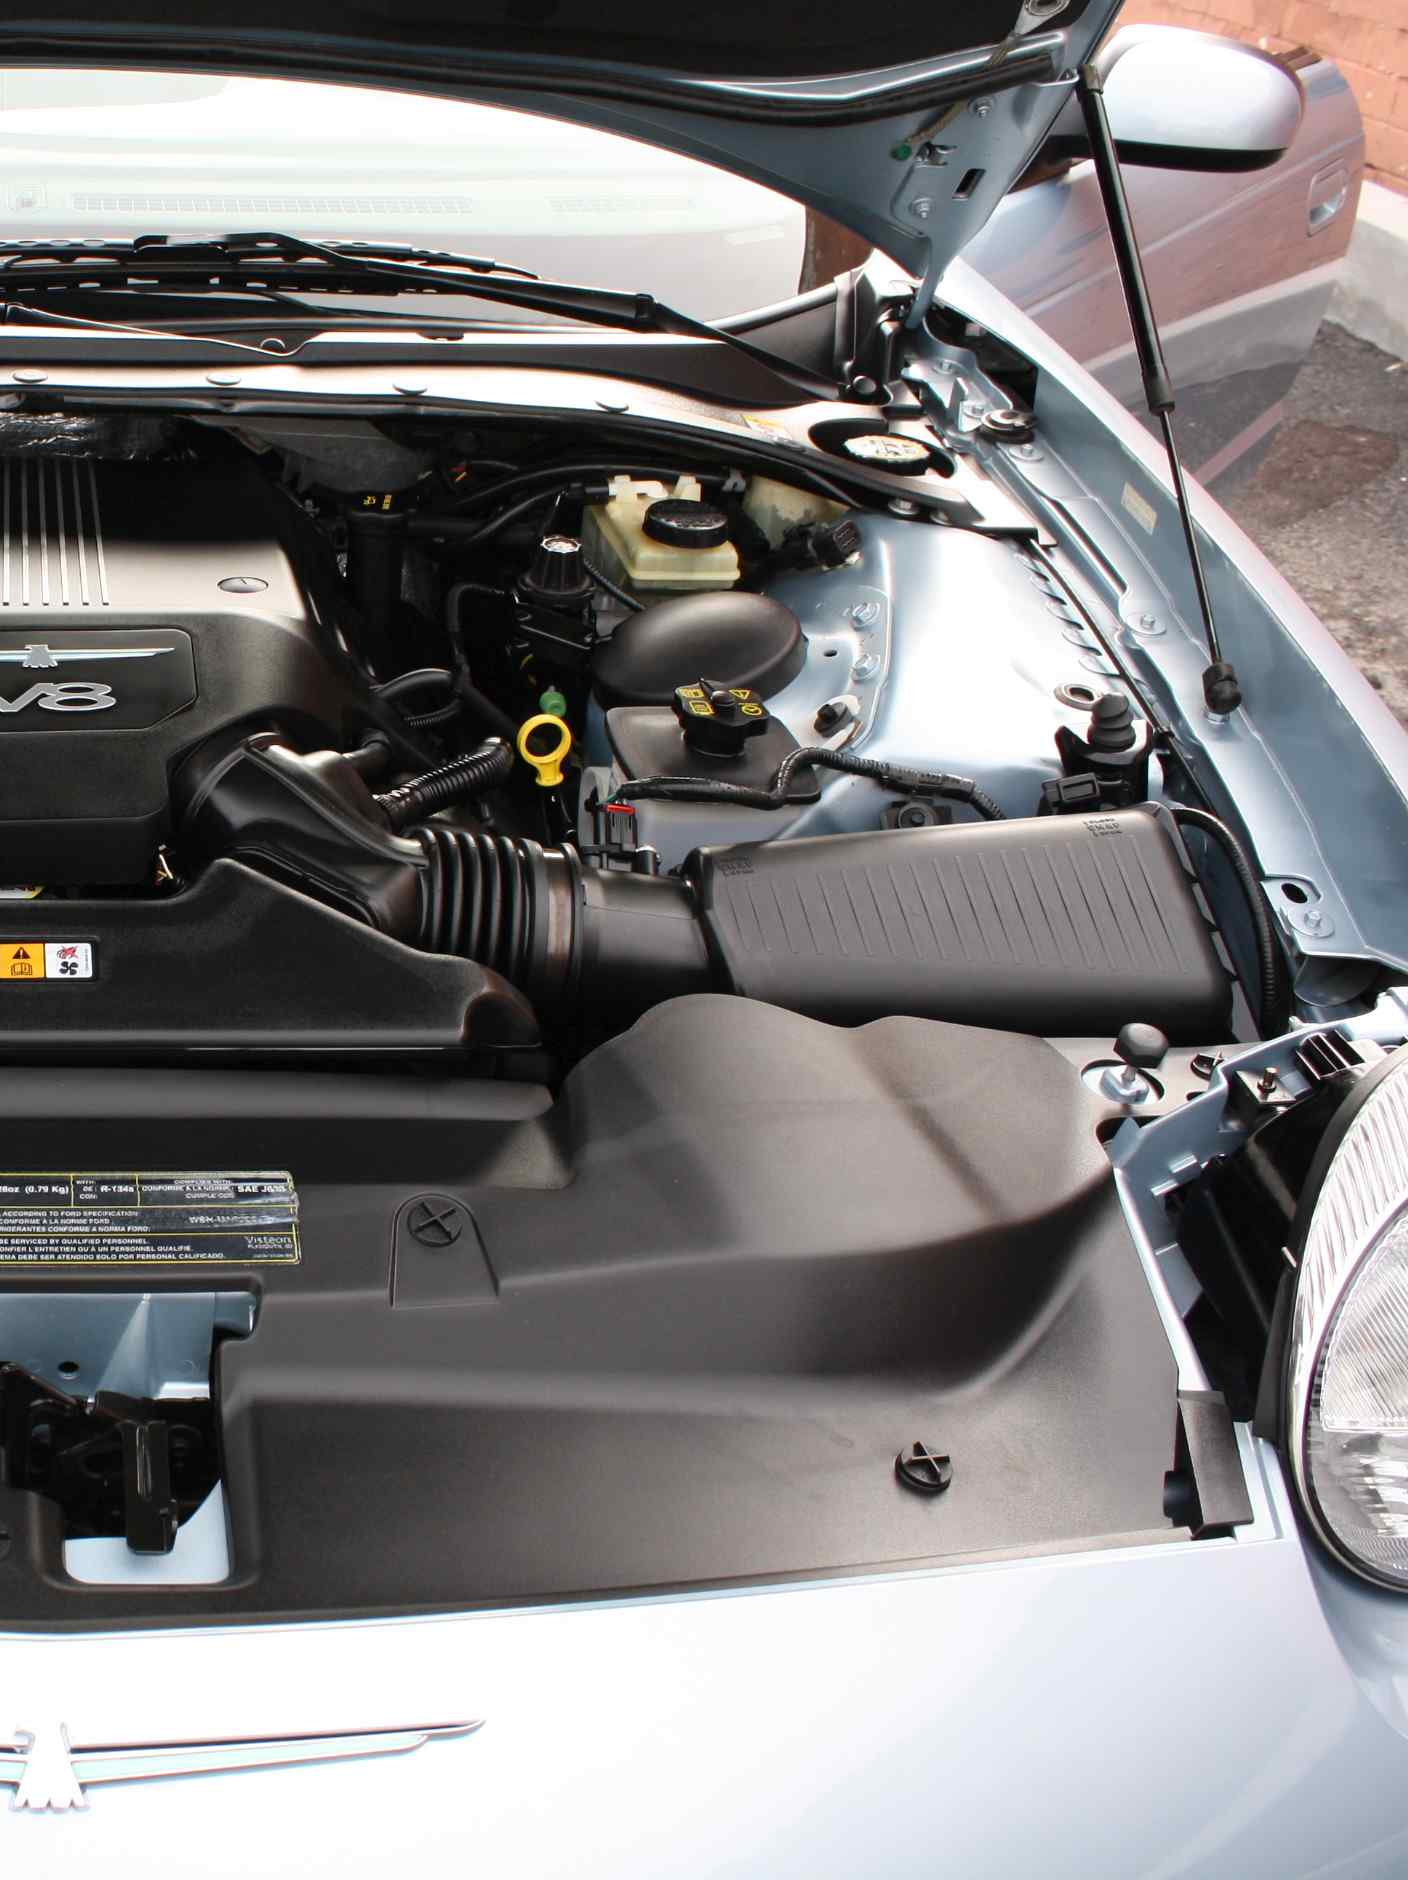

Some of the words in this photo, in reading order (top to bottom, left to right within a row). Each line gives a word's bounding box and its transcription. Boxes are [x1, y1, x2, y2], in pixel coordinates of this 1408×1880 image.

[25, 1185, 50, 1195] (0.79
[52, 1185, 69, 1195] Kg)
[238, 1185, 259, 1193] SAE
[245, 1236, 292, 1244] Visteon
